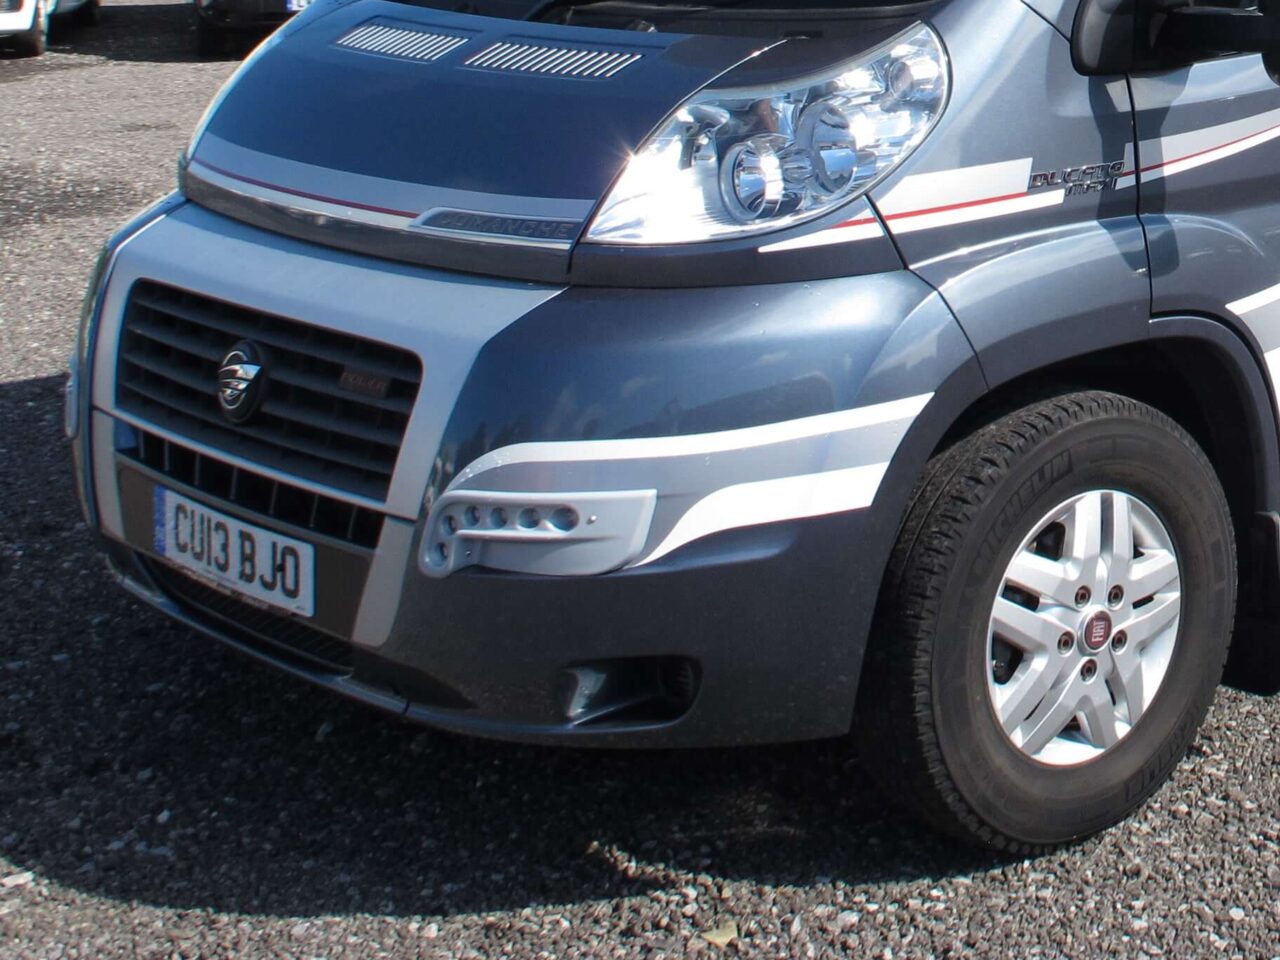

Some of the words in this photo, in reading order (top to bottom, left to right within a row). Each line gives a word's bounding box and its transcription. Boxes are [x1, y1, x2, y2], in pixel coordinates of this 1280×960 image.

[1029, 160, 1125, 188] DUCATO
[174, 503, 230, 573] CU13
[238, 528, 301, 599] BJO
[1091, 620, 1106, 643] FIAT
